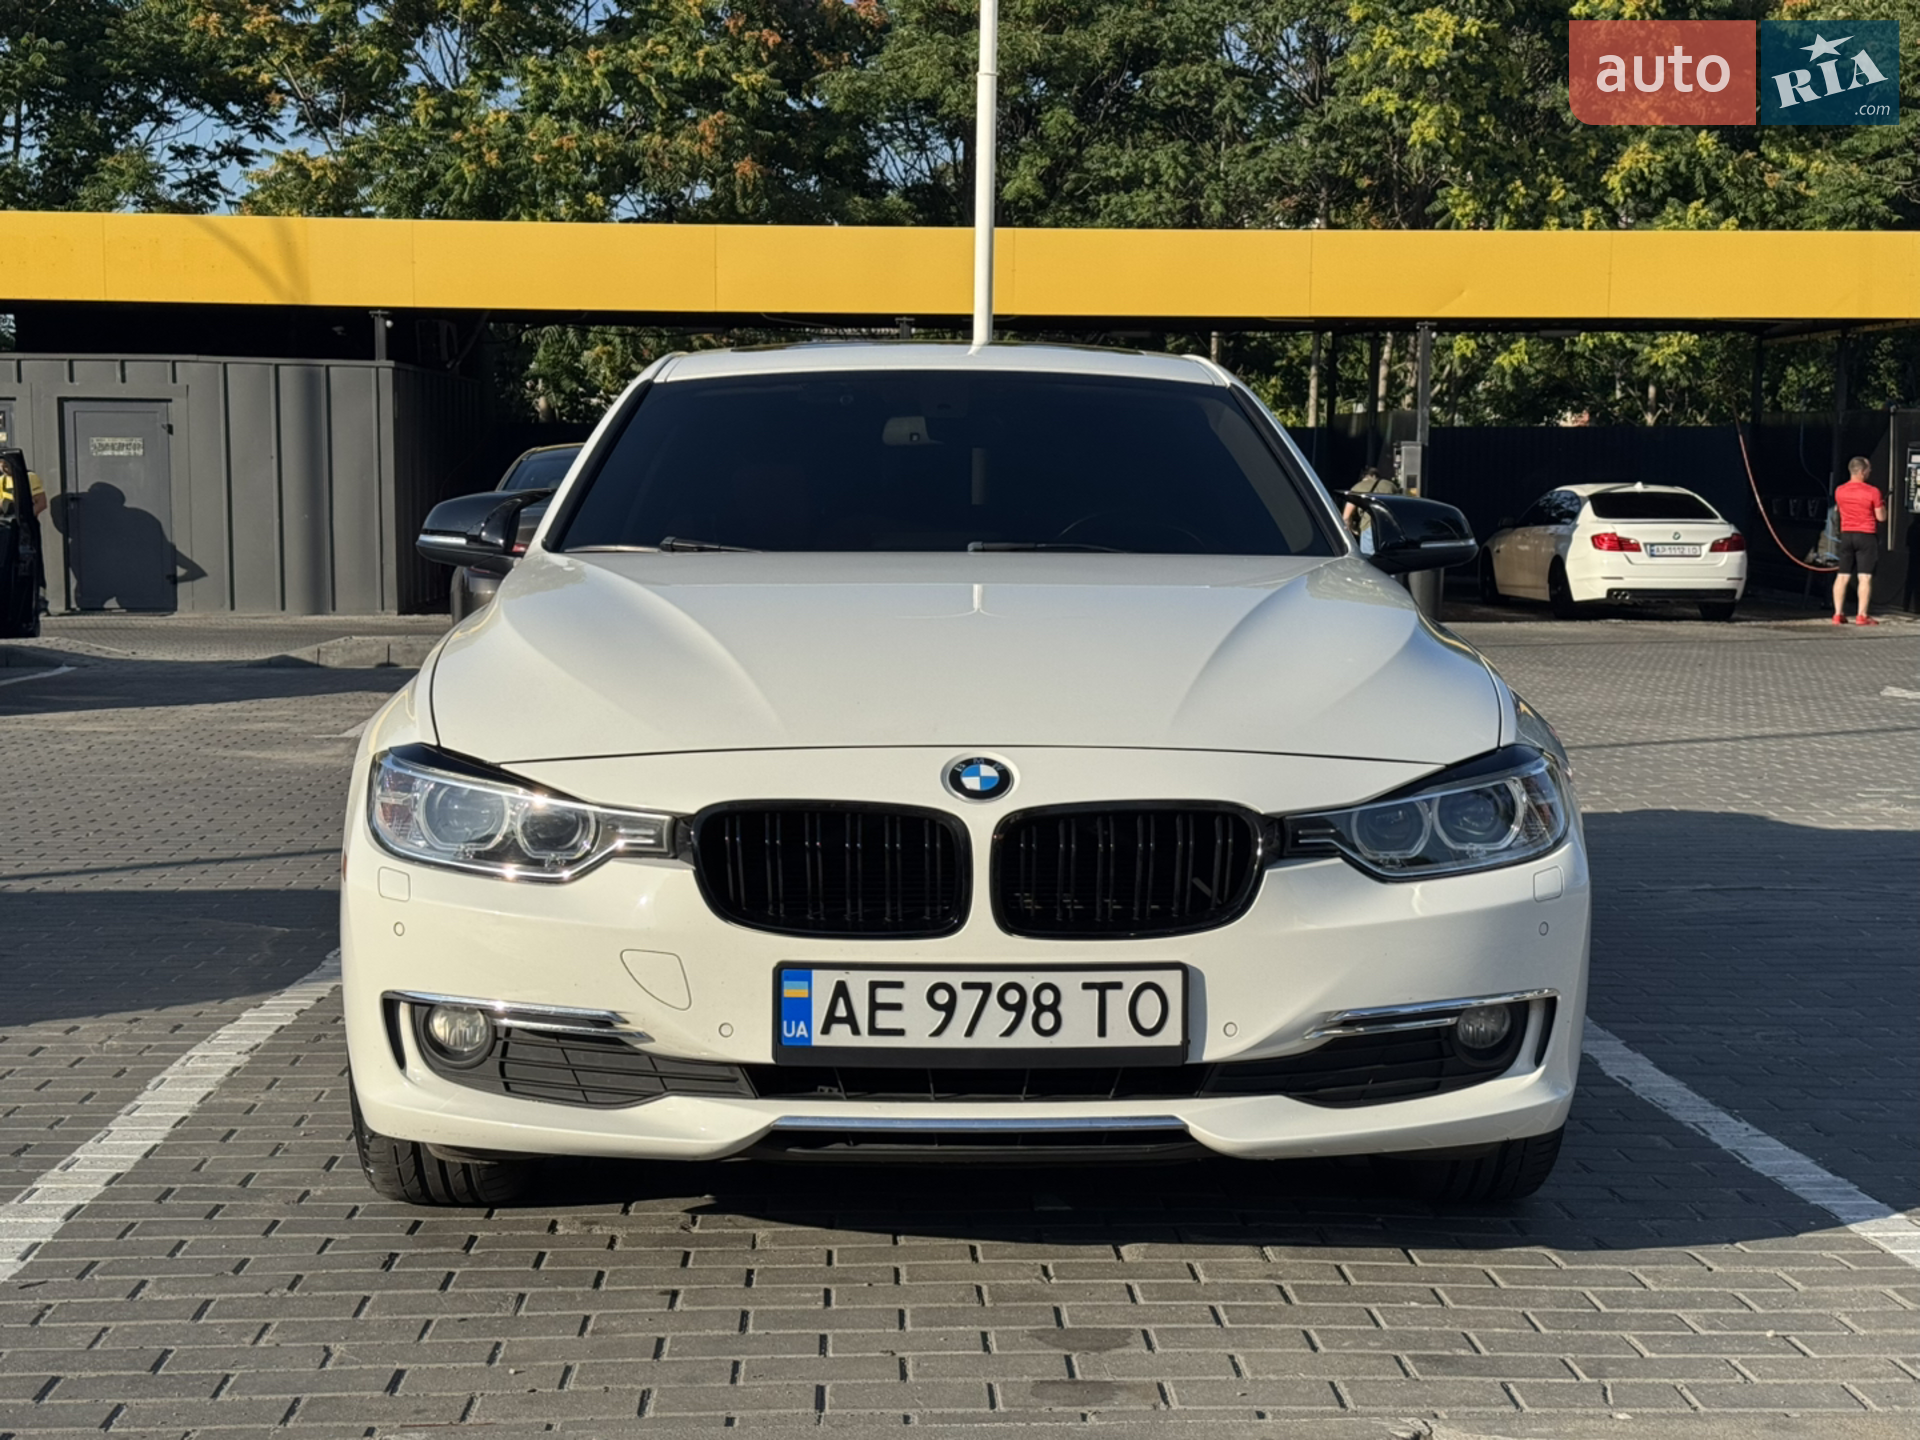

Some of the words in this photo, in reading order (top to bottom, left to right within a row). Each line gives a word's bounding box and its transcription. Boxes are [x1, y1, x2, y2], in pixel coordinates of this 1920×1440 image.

[954, 758, 1005, 772] BMW
[819, 979, 906, 1037] AE
[925, 981, 1063, 1038] 9798
[1081, 981, 1169, 1038] TO
[783, 1020, 809, 1038] UA
